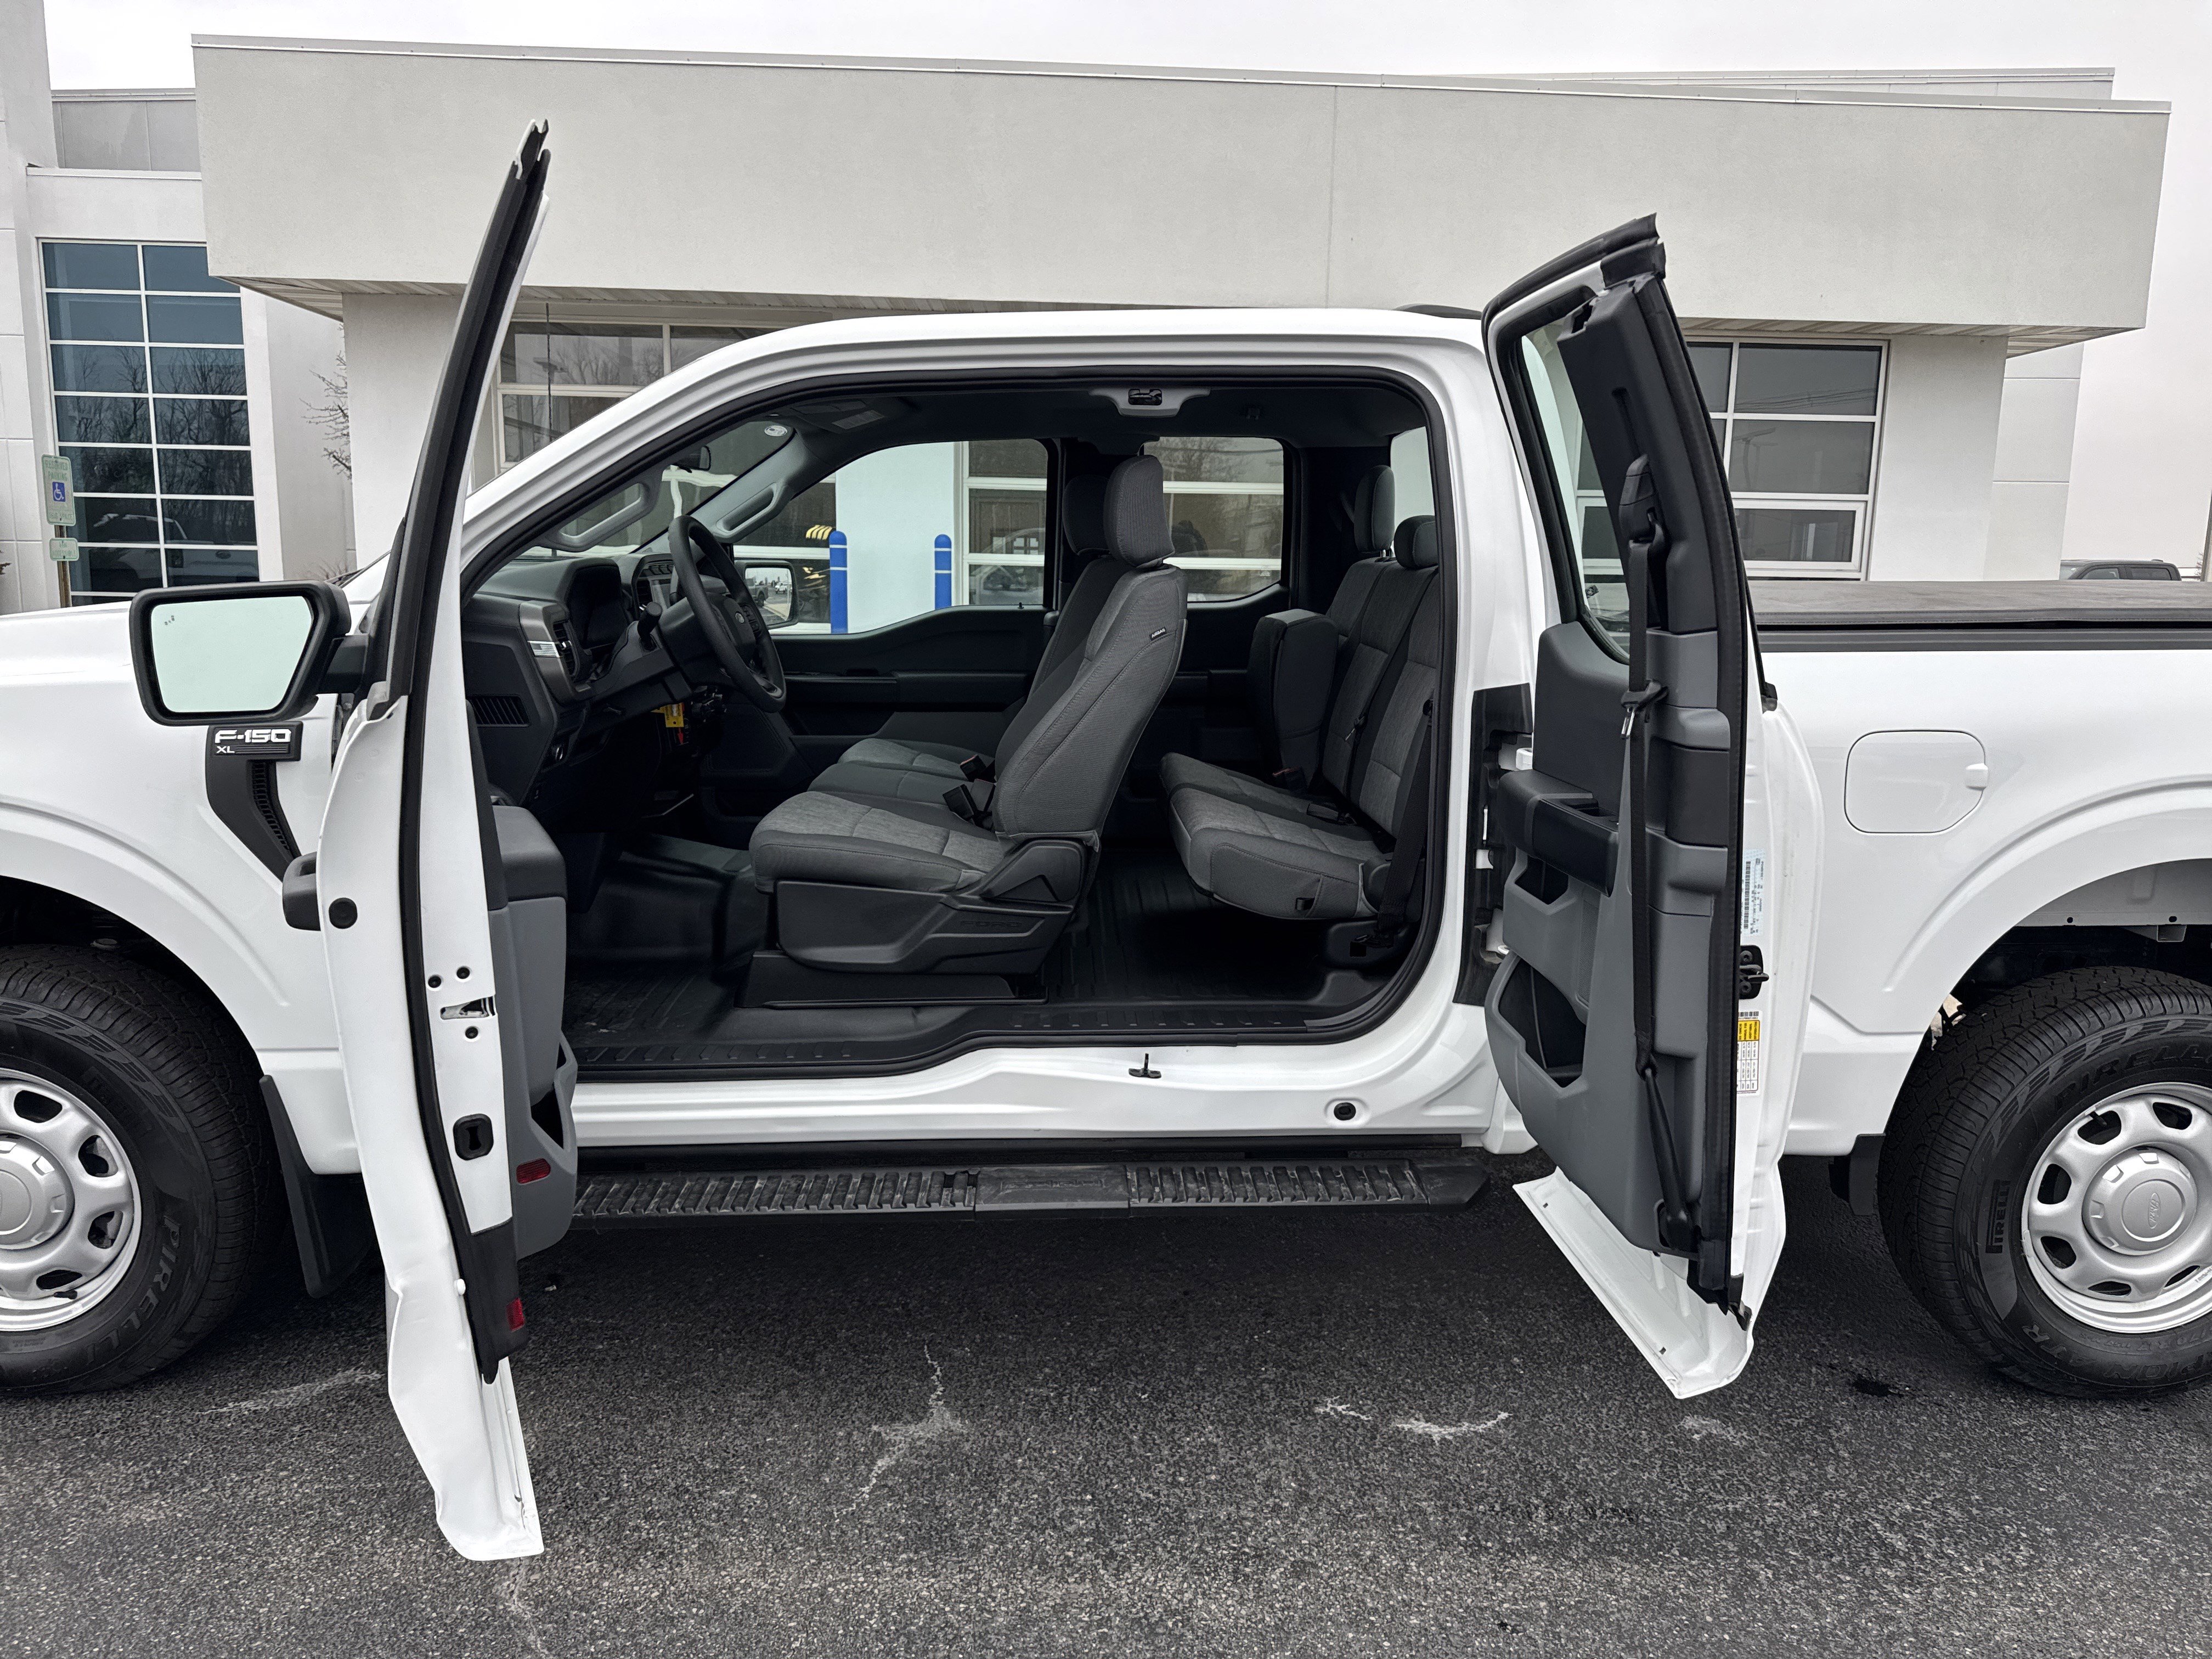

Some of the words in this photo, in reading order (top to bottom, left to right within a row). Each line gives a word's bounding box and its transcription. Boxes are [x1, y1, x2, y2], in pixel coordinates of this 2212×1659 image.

[215, 729, 291, 743] F-150
[1985, 1180, 2010, 1254] PIRELLI
[87, 1215, 180, 1363] PIRELLI
